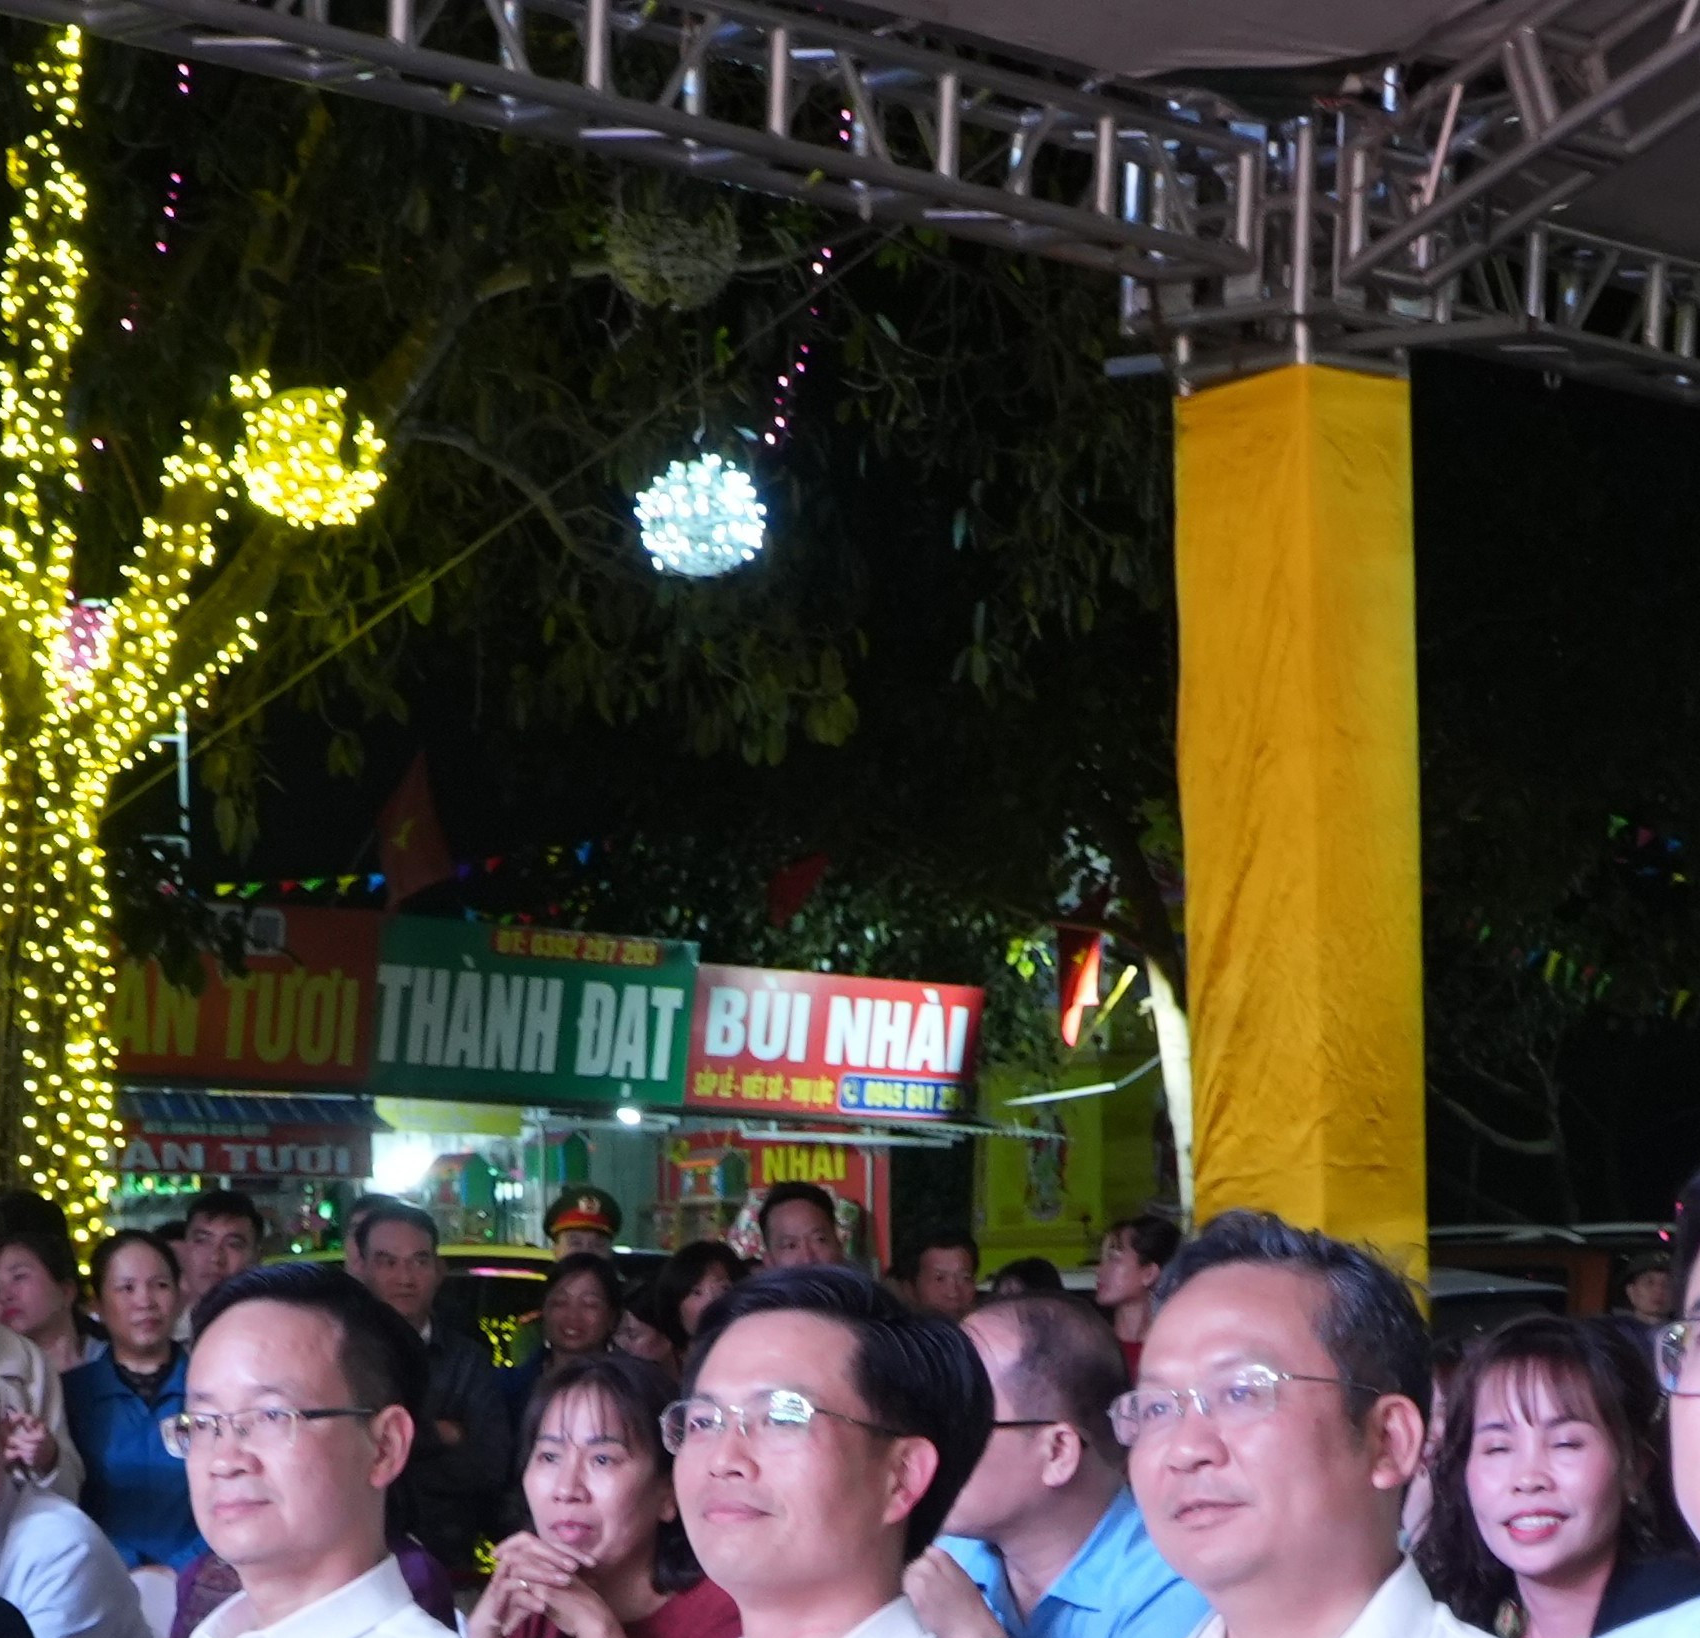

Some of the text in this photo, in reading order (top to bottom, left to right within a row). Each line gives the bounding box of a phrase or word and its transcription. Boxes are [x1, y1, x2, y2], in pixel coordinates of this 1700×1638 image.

[225, 966, 359, 1067] TƯƠI
[378, 954, 684, 1099] THÀNH ĐẠT
[704, 975, 969, 1074] BÙI NHÀI
